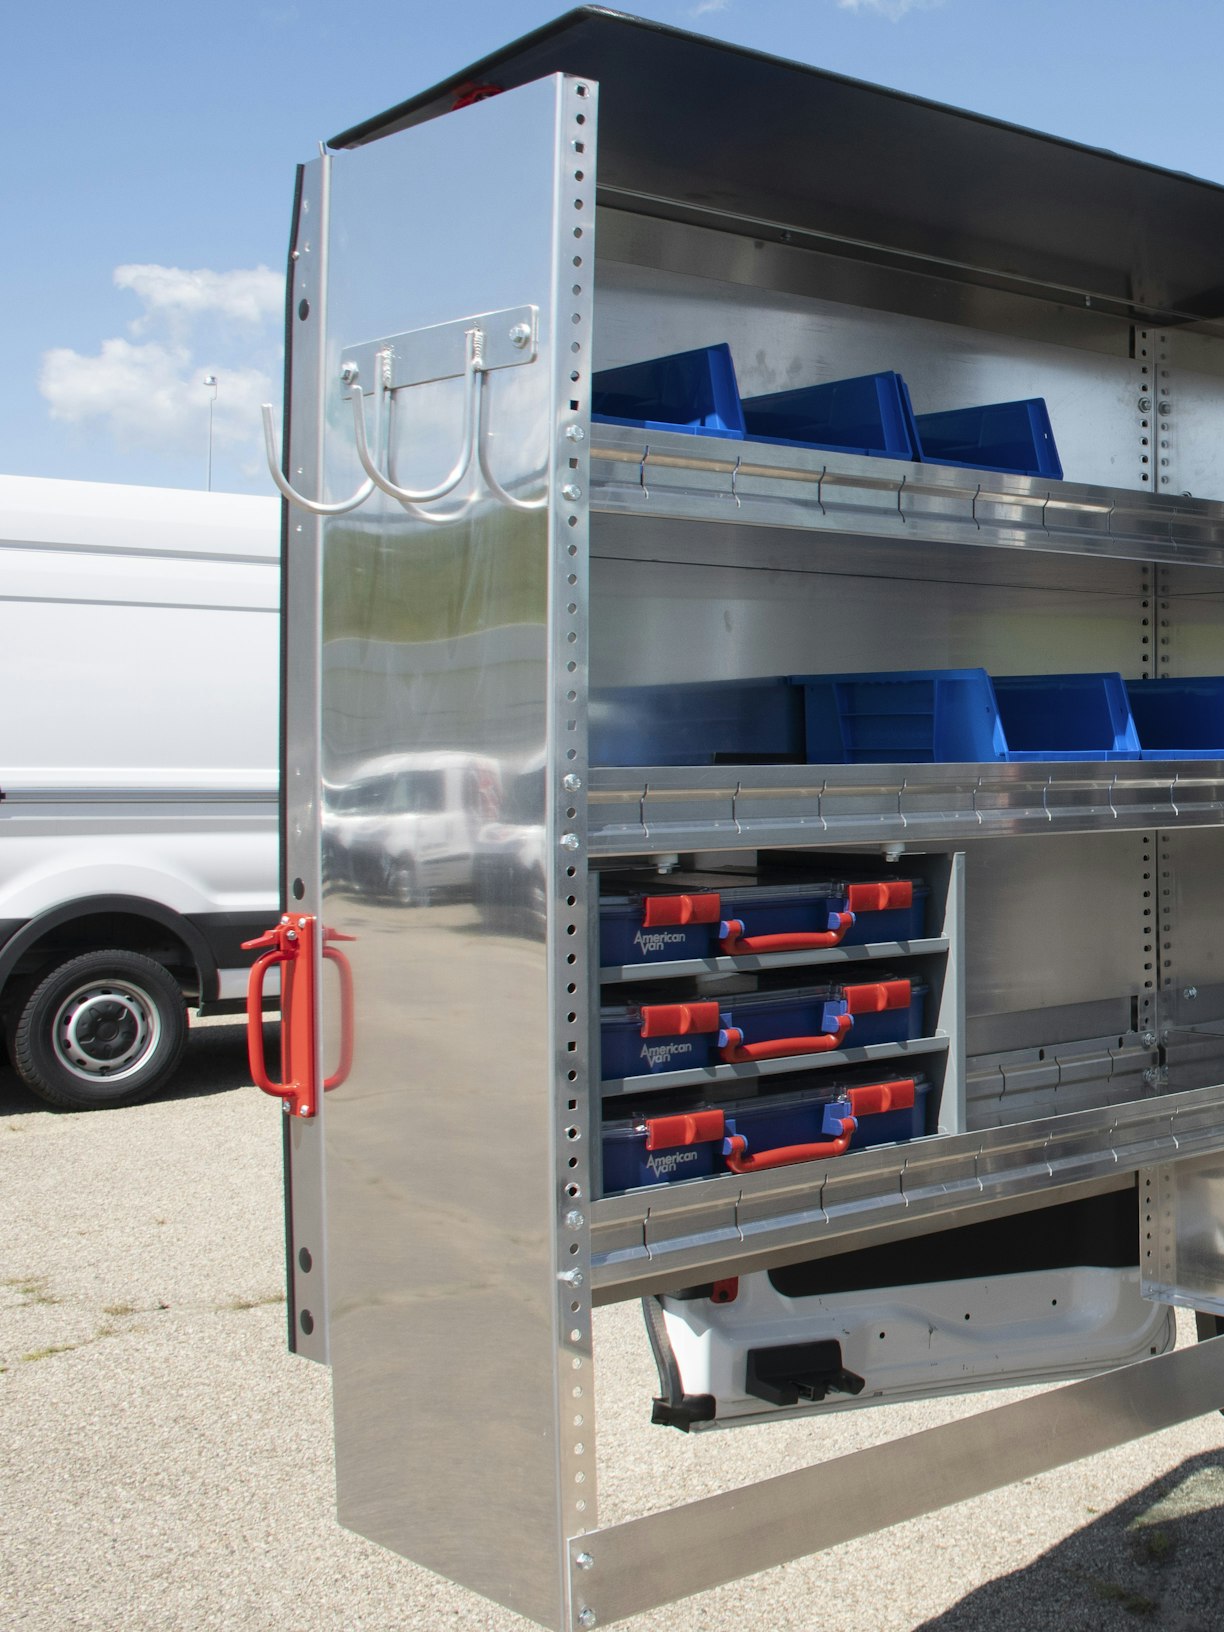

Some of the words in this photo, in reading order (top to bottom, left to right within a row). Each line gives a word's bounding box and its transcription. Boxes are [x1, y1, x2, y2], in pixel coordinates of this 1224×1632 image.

[633, 929, 686, 944] American
[640, 1043, 692, 1058] American
[646, 1152, 698, 1168] American
